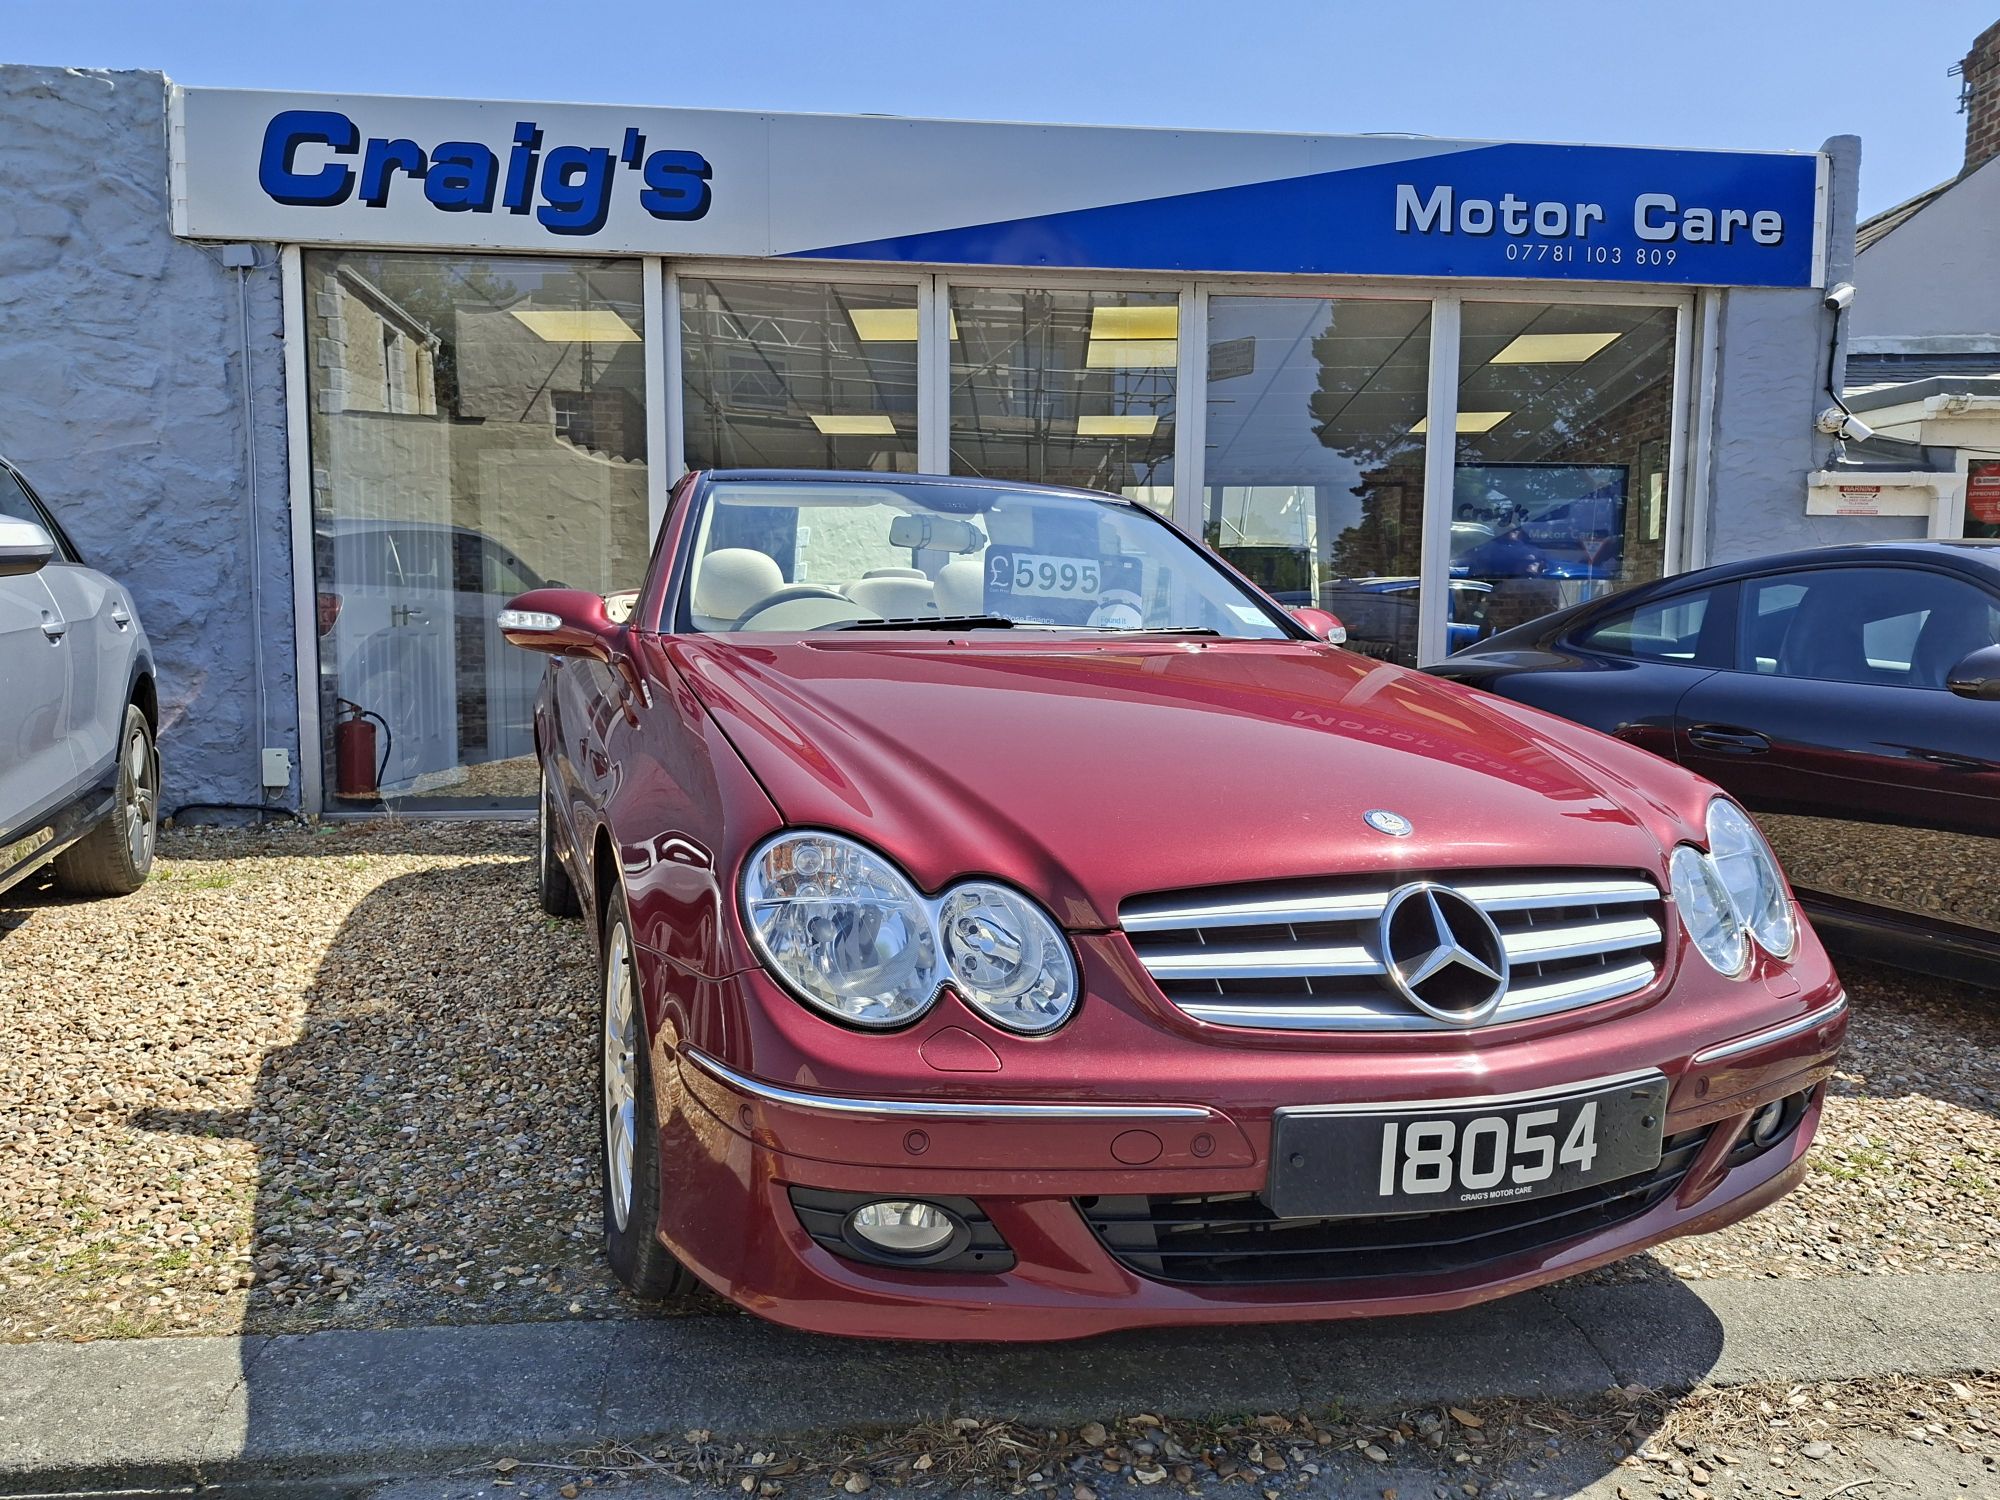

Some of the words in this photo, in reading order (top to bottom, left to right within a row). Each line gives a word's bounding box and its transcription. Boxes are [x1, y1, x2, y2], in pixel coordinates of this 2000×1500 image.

[258, 110, 713, 236] Craig's
[1396, 184, 1603, 238] Motor
[1634, 193, 1784, 245] Care
[1506, 243, 1573, 262] 07781
[1587, 246, 1622, 264] 103
[1636, 248, 1677, 266] 809
[1457, 503, 1530, 527] Craig's
[1529, 529, 1567, 539] Motor
[1025, 615, 1055, 624] Finance
[1100, 616, 1121, 624] Found
[1379, 1101, 1598, 1196] 18054
[1460, 1192, 1489, 1201] CRAIG'S
[1489, 1188, 1514, 1198] MOTOR
[1514, 1185, 1533, 1195] CARE
